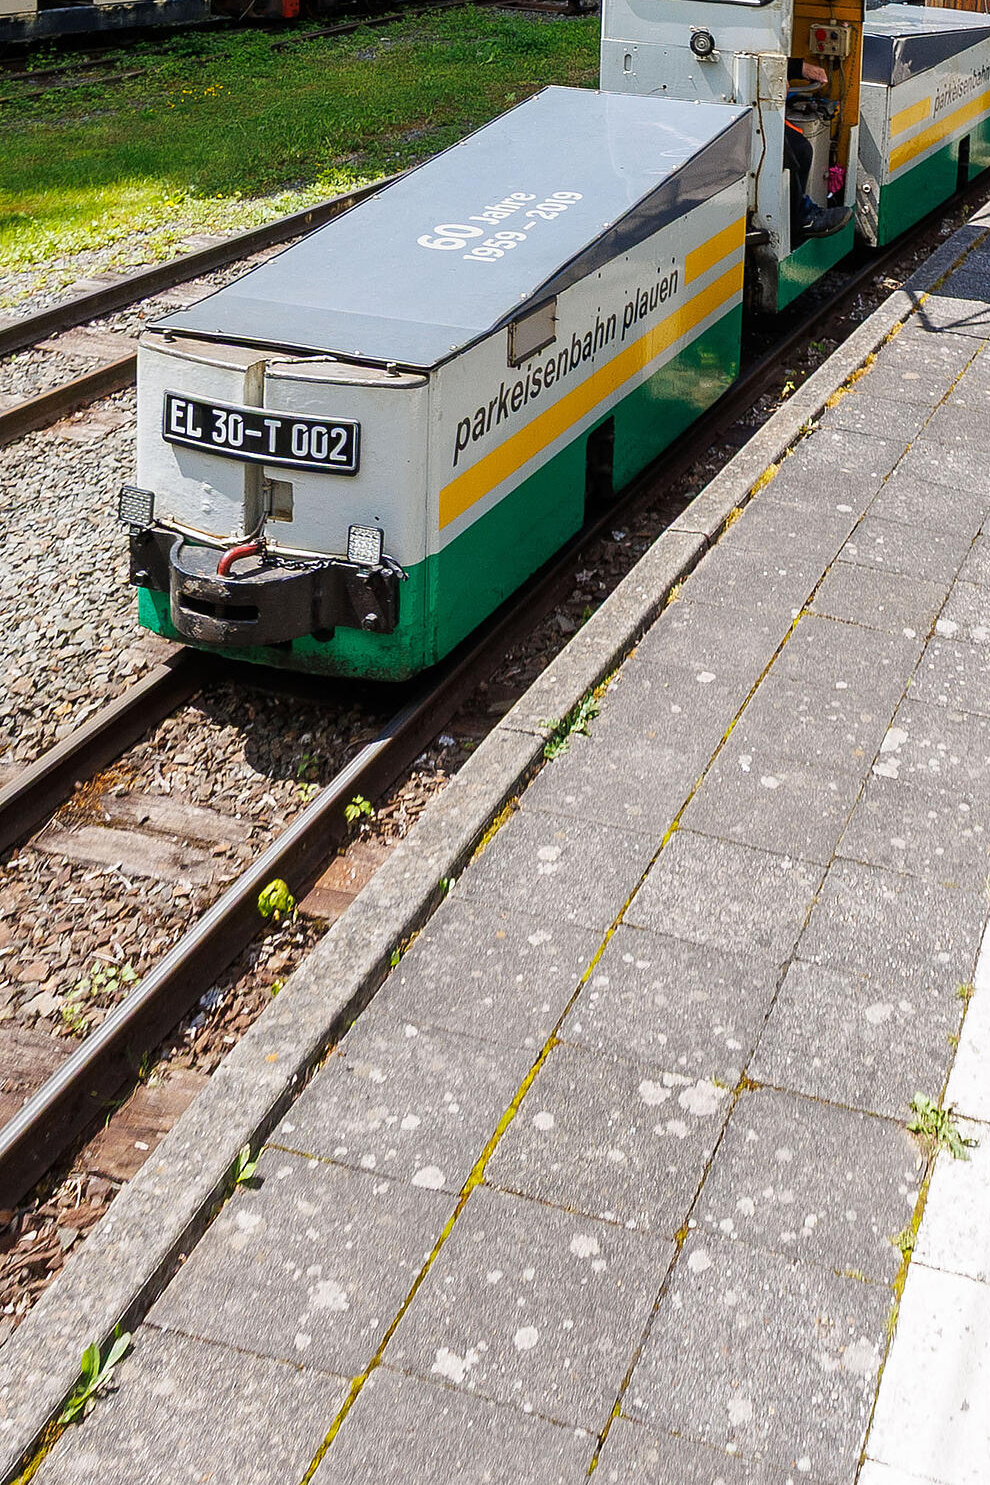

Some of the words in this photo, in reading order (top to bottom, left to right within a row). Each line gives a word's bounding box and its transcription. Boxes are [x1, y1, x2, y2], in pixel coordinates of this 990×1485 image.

[933, 64, 990, 119] parkeisenbahn
[417, 224, 484, 251] 60
[469, 192, 537, 226] Jahre
[463, 231, 527, 263] 1959
[525, 191, 584, 220] 2019
[453, 313, 617, 467] parkeisenbahn
[621, 270, 679, 341] plauen
[170, 399, 202, 438] EL
[211, 409, 282, 453] 30-T
[291, 423, 348, 462] 002
